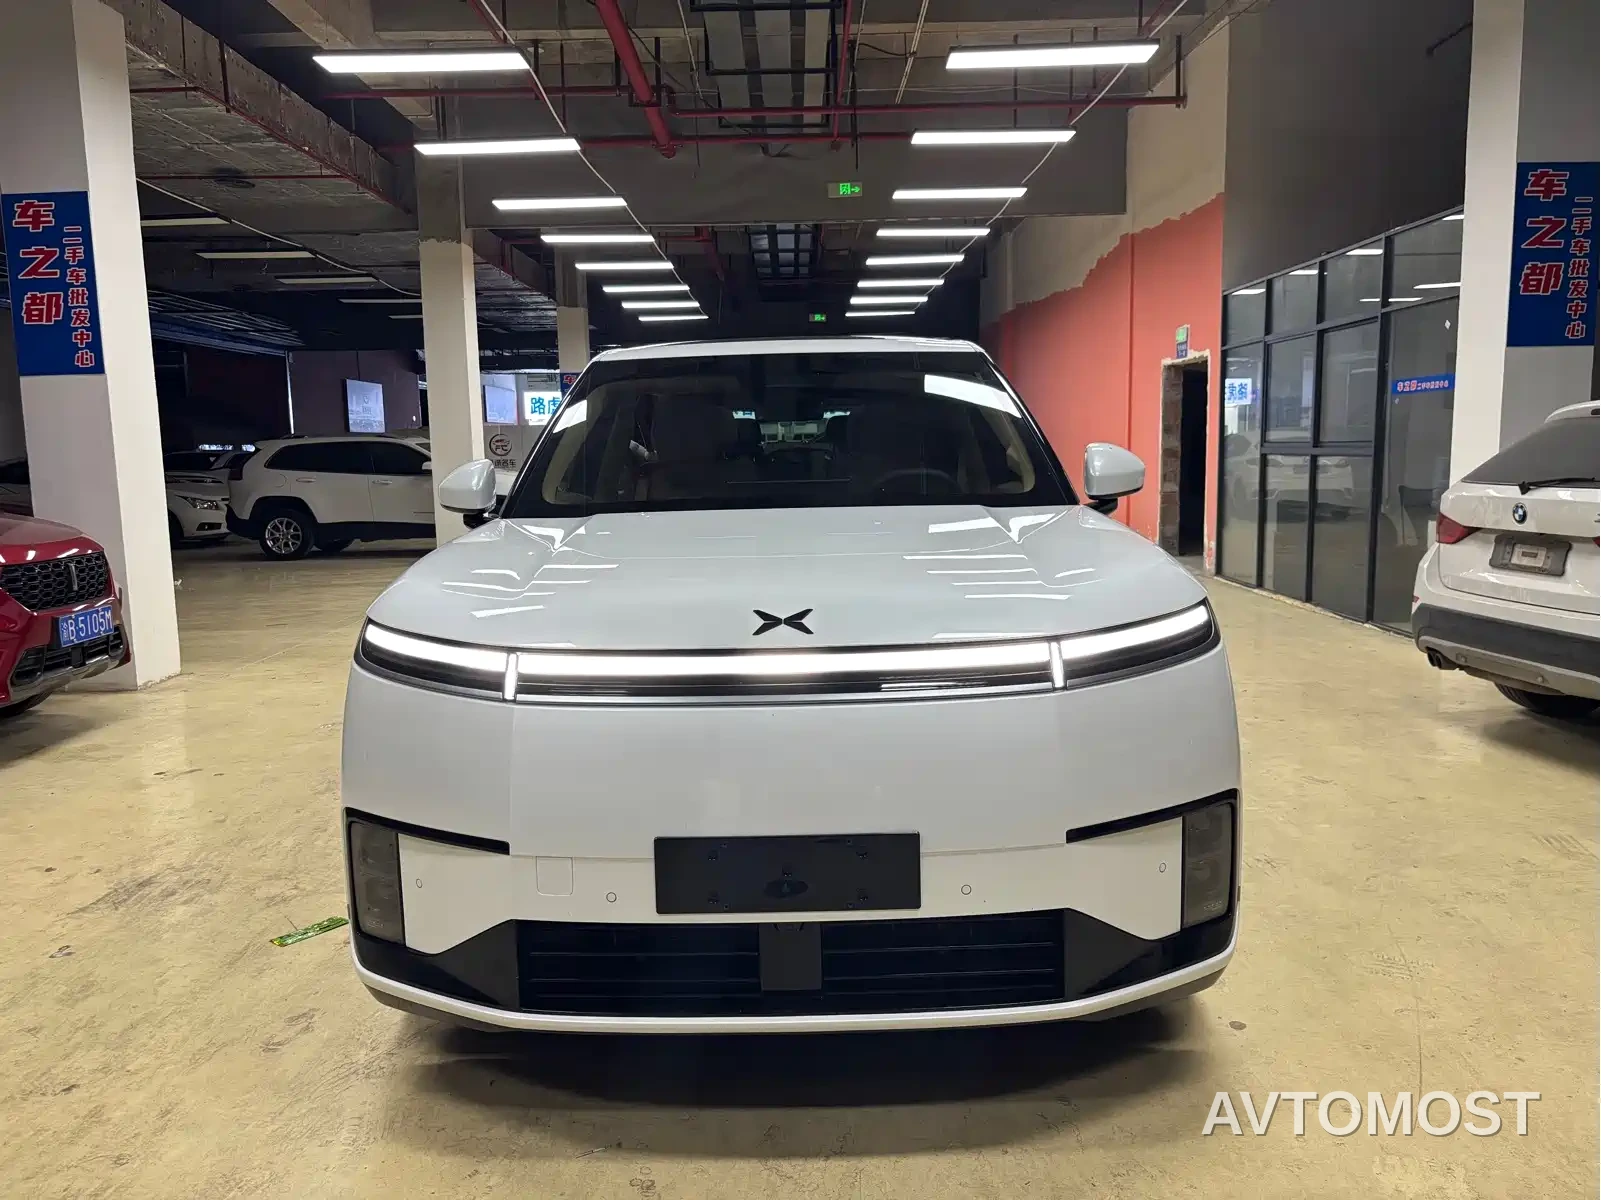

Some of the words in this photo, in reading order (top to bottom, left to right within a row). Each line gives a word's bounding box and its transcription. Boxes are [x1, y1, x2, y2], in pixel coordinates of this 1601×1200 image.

[13, 200, 63, 325] 车之都
[63, 225, 95, 368] 二手车批发中心
[1520, 169, 1569, 296] 车之都
[1564, 196, 1594, 339] 二手车批发中心
